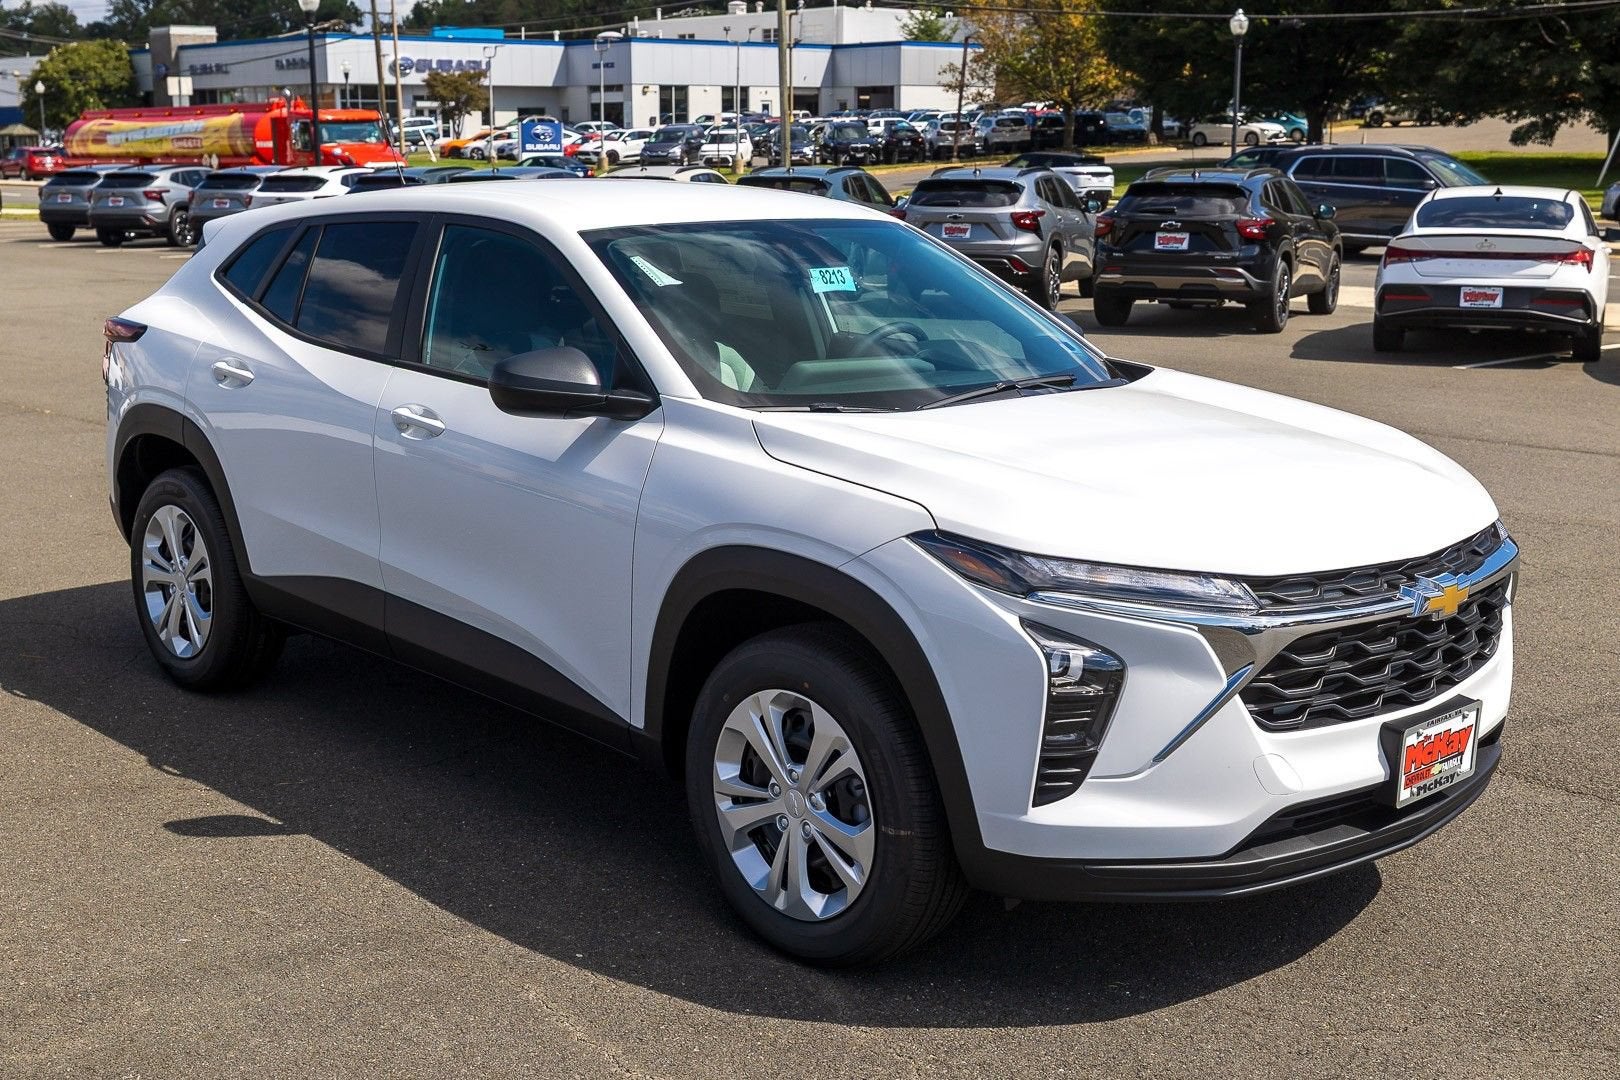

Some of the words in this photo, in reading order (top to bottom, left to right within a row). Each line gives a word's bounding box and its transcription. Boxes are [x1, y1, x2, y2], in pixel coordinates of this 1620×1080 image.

[525, 143, 560, 151] SUBARU
[819, 269, 846, 285] 8213
[1403, 723, 1474, 775] McKay
[1416, 772, 1456, 797] McKay
